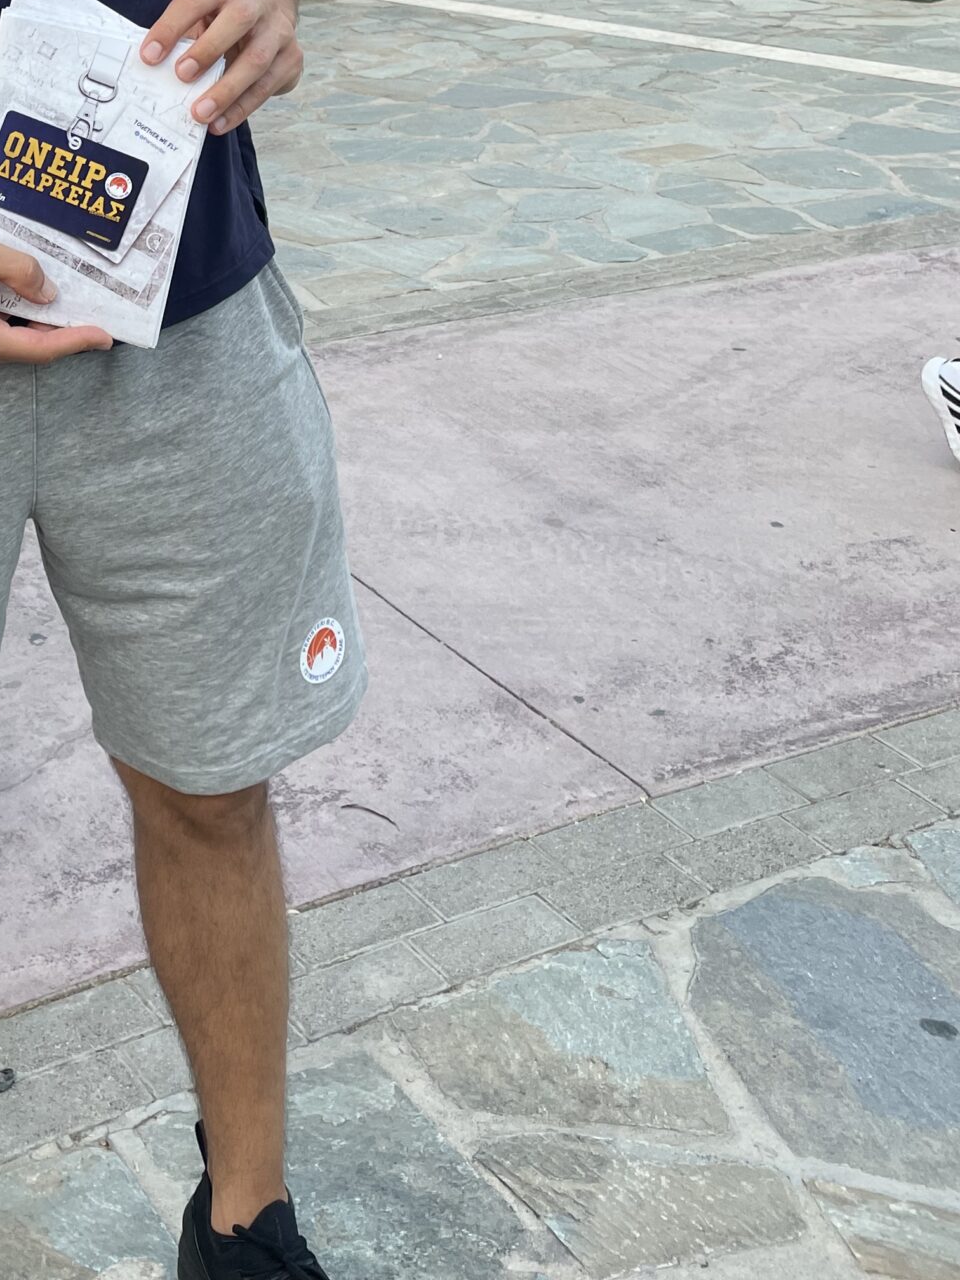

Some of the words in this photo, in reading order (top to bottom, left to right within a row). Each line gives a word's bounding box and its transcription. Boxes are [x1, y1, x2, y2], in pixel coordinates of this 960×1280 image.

[134, 119, 160, 140] TOGETHER
[159, 136, 168, 145] WE
[167, 142, 179, 151] FLY
[3, 130, 107, 190] ΟΝΕΙΡ
[0, 294, 17, 310] VIP
